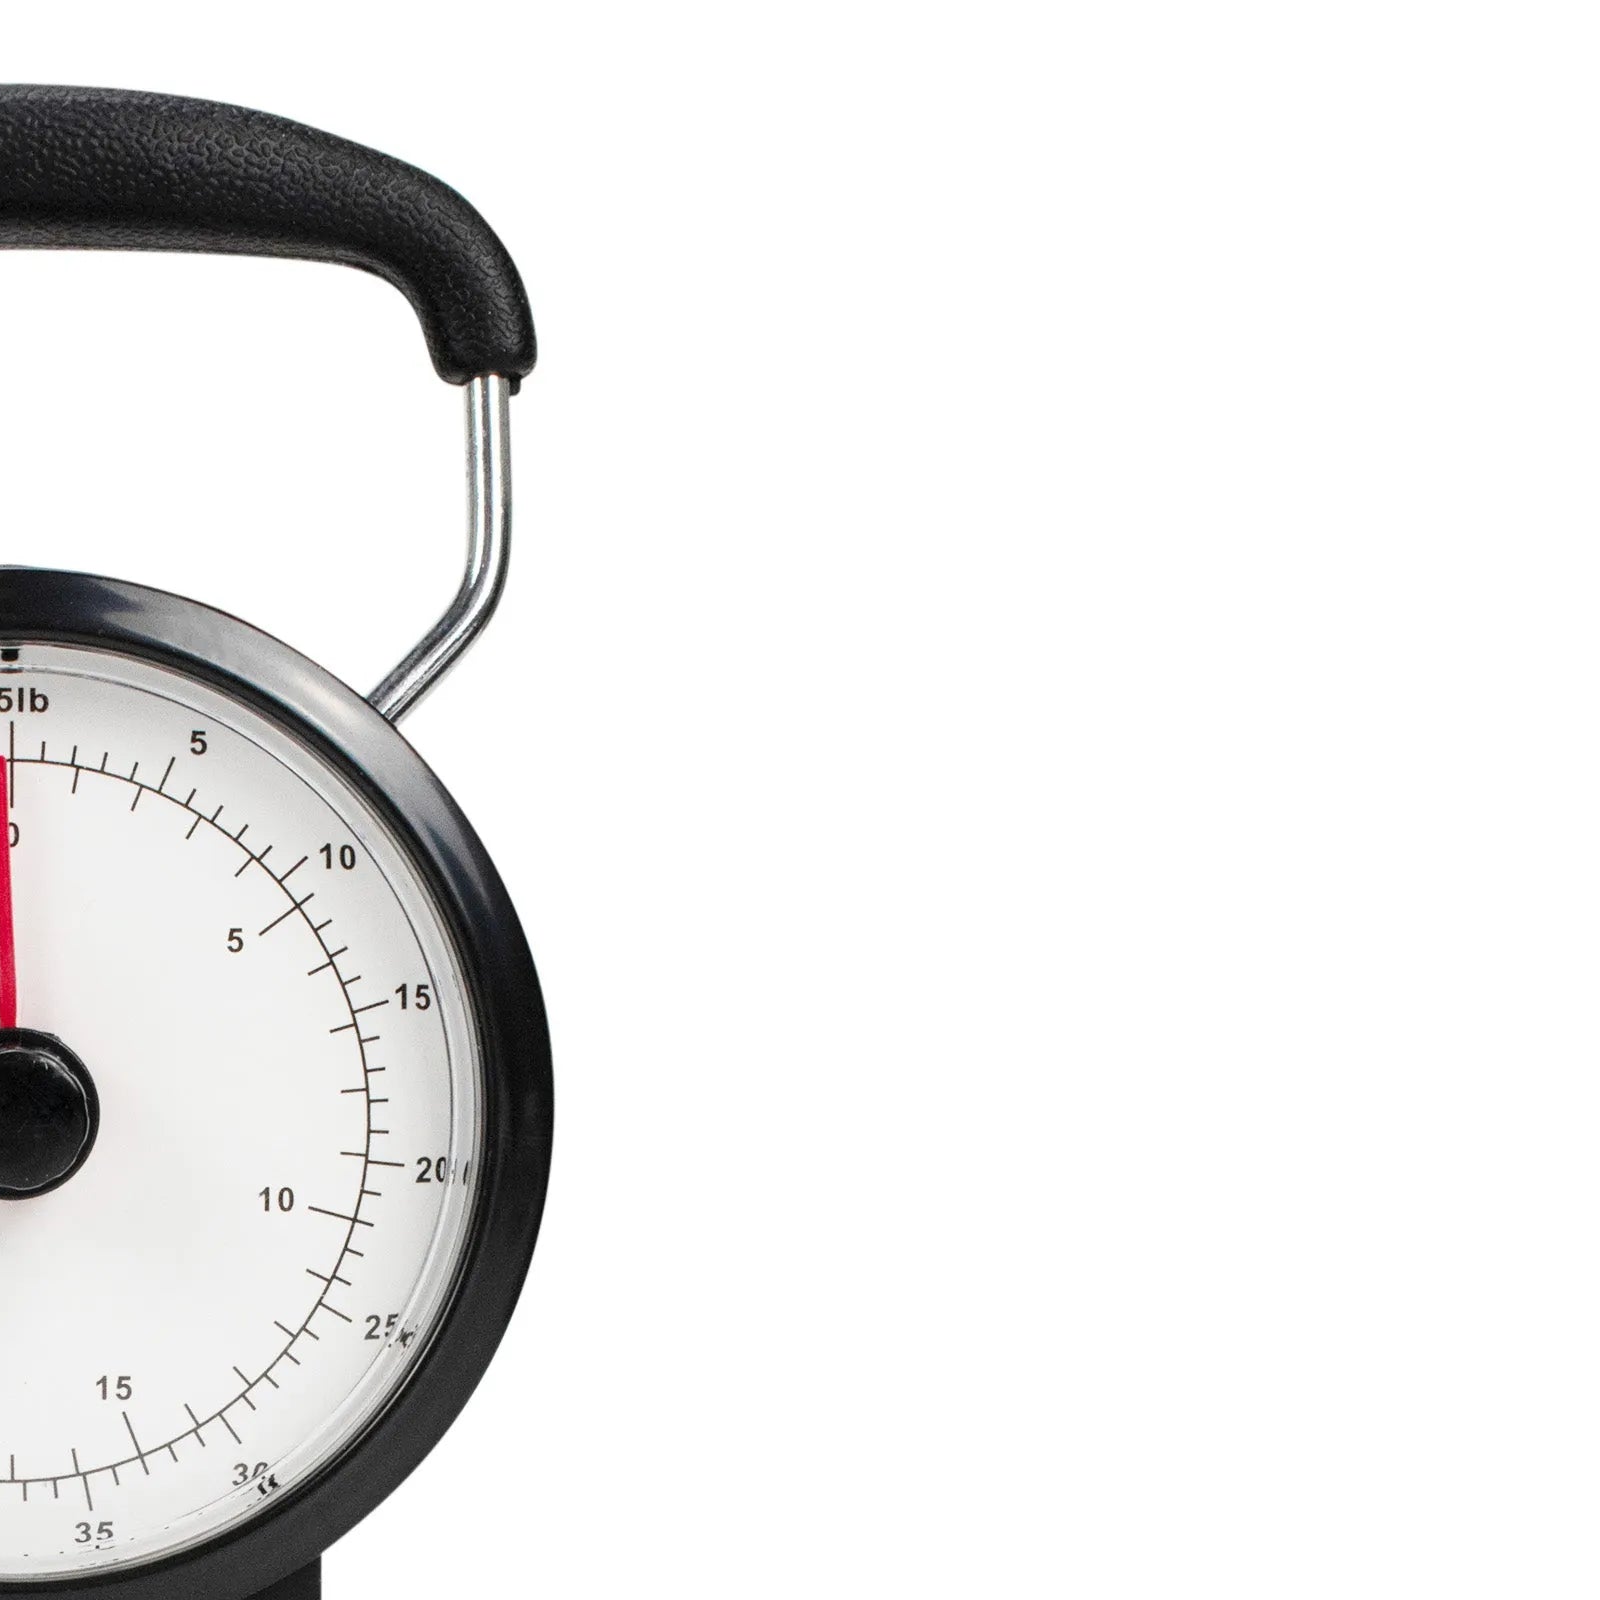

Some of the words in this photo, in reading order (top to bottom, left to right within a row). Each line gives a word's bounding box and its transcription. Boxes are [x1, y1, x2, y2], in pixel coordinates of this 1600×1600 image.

[190, 731, 208, 755] 5
[319, 845, 357, 870] 10
[227, 929, 244, 953] 5
[395, 984, 432, 1010] 15
[416, 1157, 447, 1183] 20
[259, 1187, 295, 1212] 10
[96, 1376, 133, 1401] 15
[74, 1521, 114, 1546] 35
